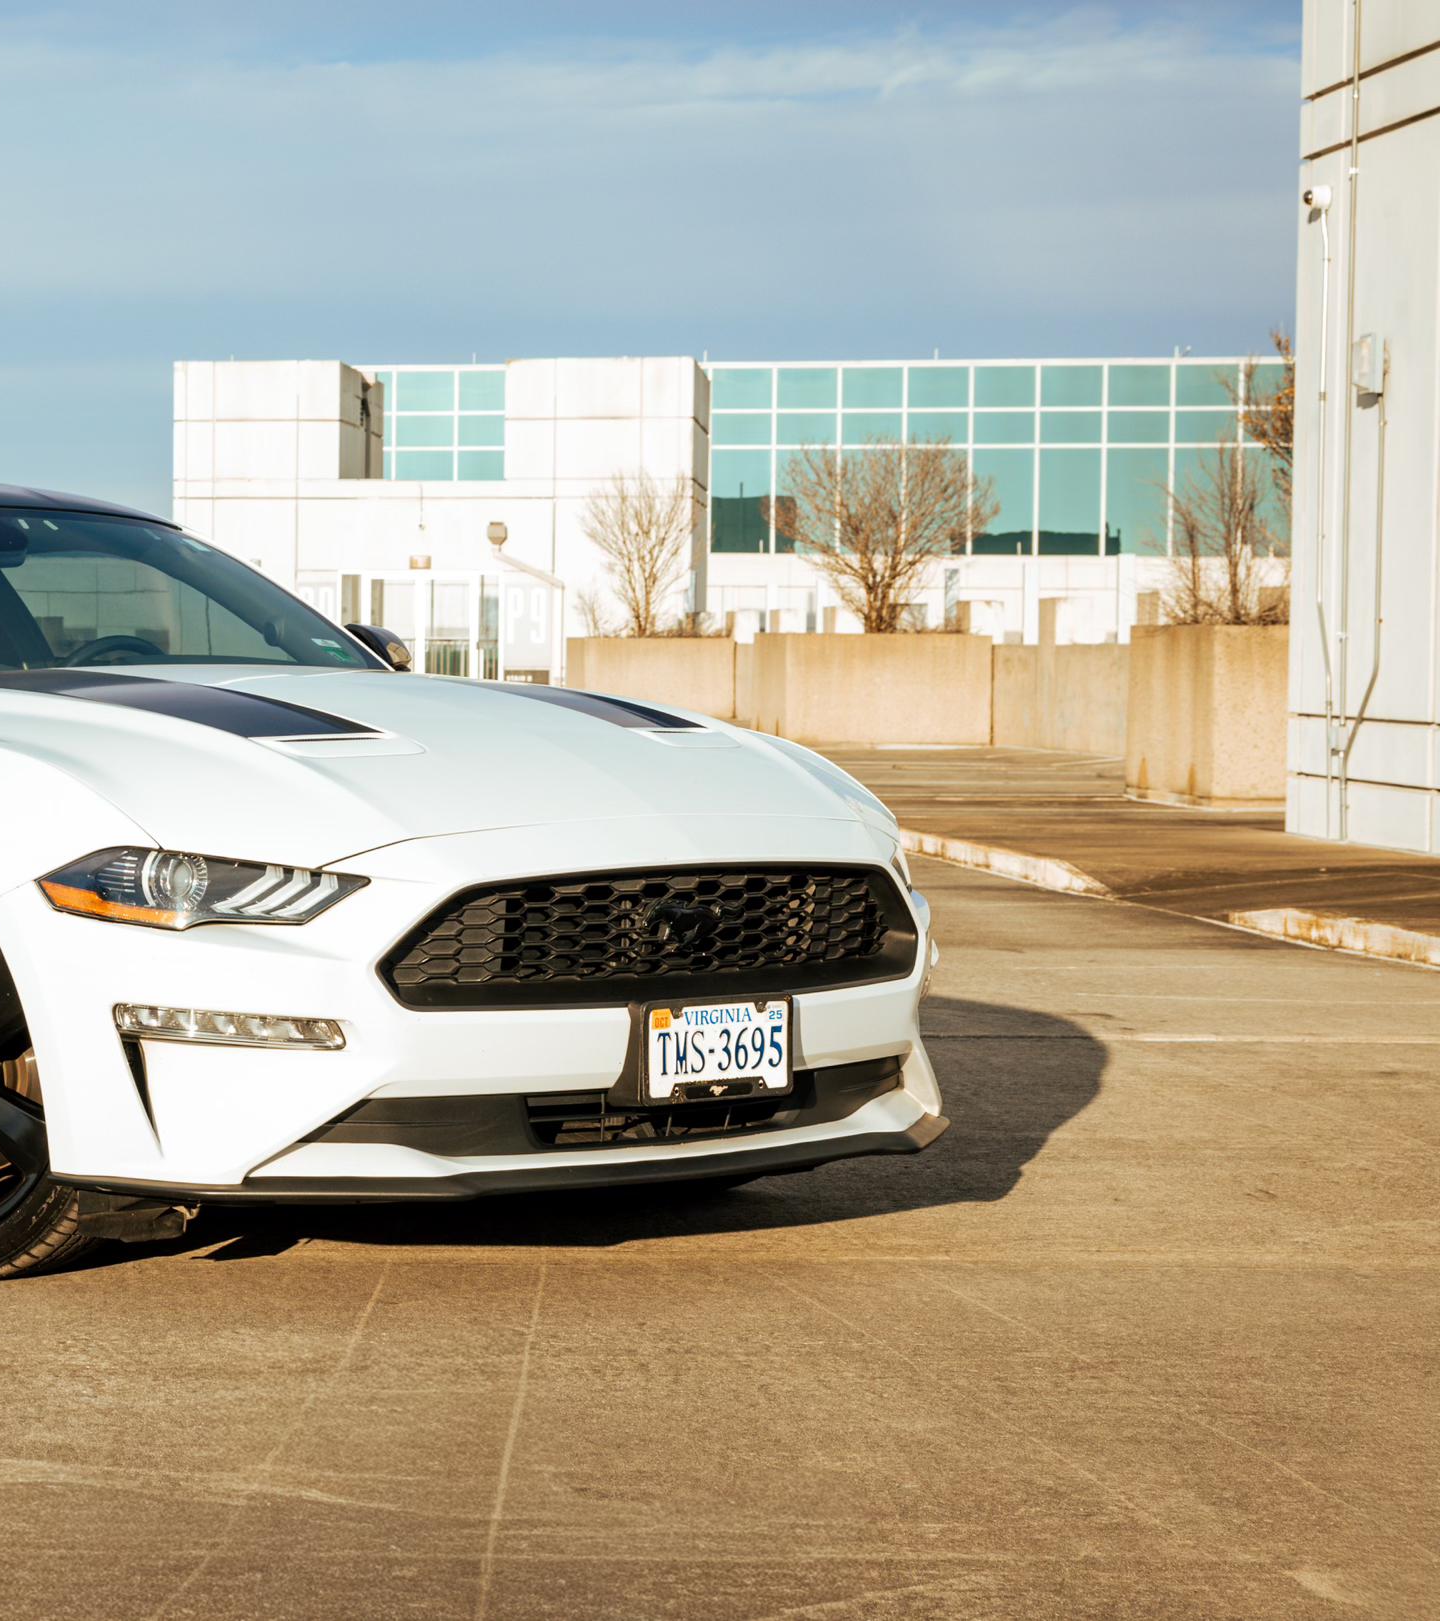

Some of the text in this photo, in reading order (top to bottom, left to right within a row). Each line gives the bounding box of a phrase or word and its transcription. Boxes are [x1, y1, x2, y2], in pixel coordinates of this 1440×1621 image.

[506, 587, 547, 645] P9
[654, 1016, 669, 1029] OCT
[684, 1008, 752, 1025] VIRGINIA
[768, 1010, 783, 1020] 25
[657, 1025, 782, 1075] TMS-3695
